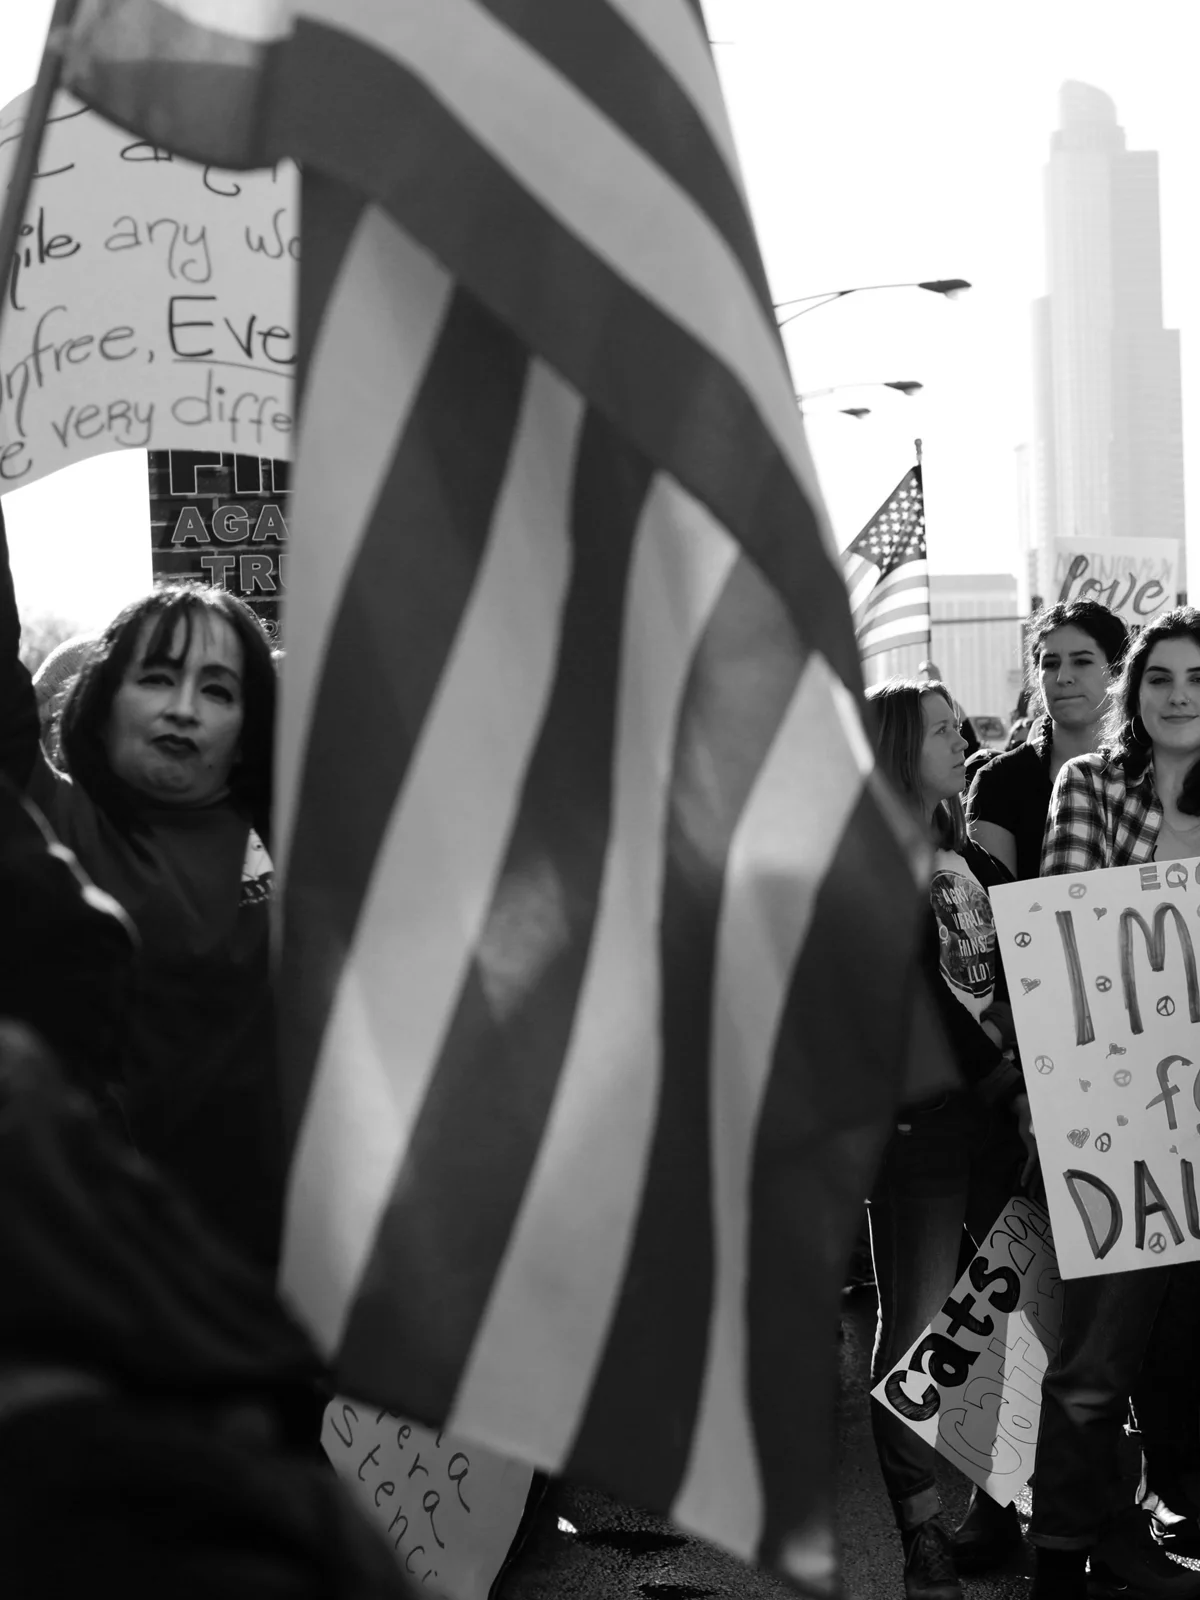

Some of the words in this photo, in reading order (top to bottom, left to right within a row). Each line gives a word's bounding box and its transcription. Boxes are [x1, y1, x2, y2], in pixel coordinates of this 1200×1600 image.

[104, 215, 212, 283] any
[0, 306, 154, 436] nfree,
[1055, 911, 1096, 1046] I
[885, 1256, 1021, 1422] Cats
